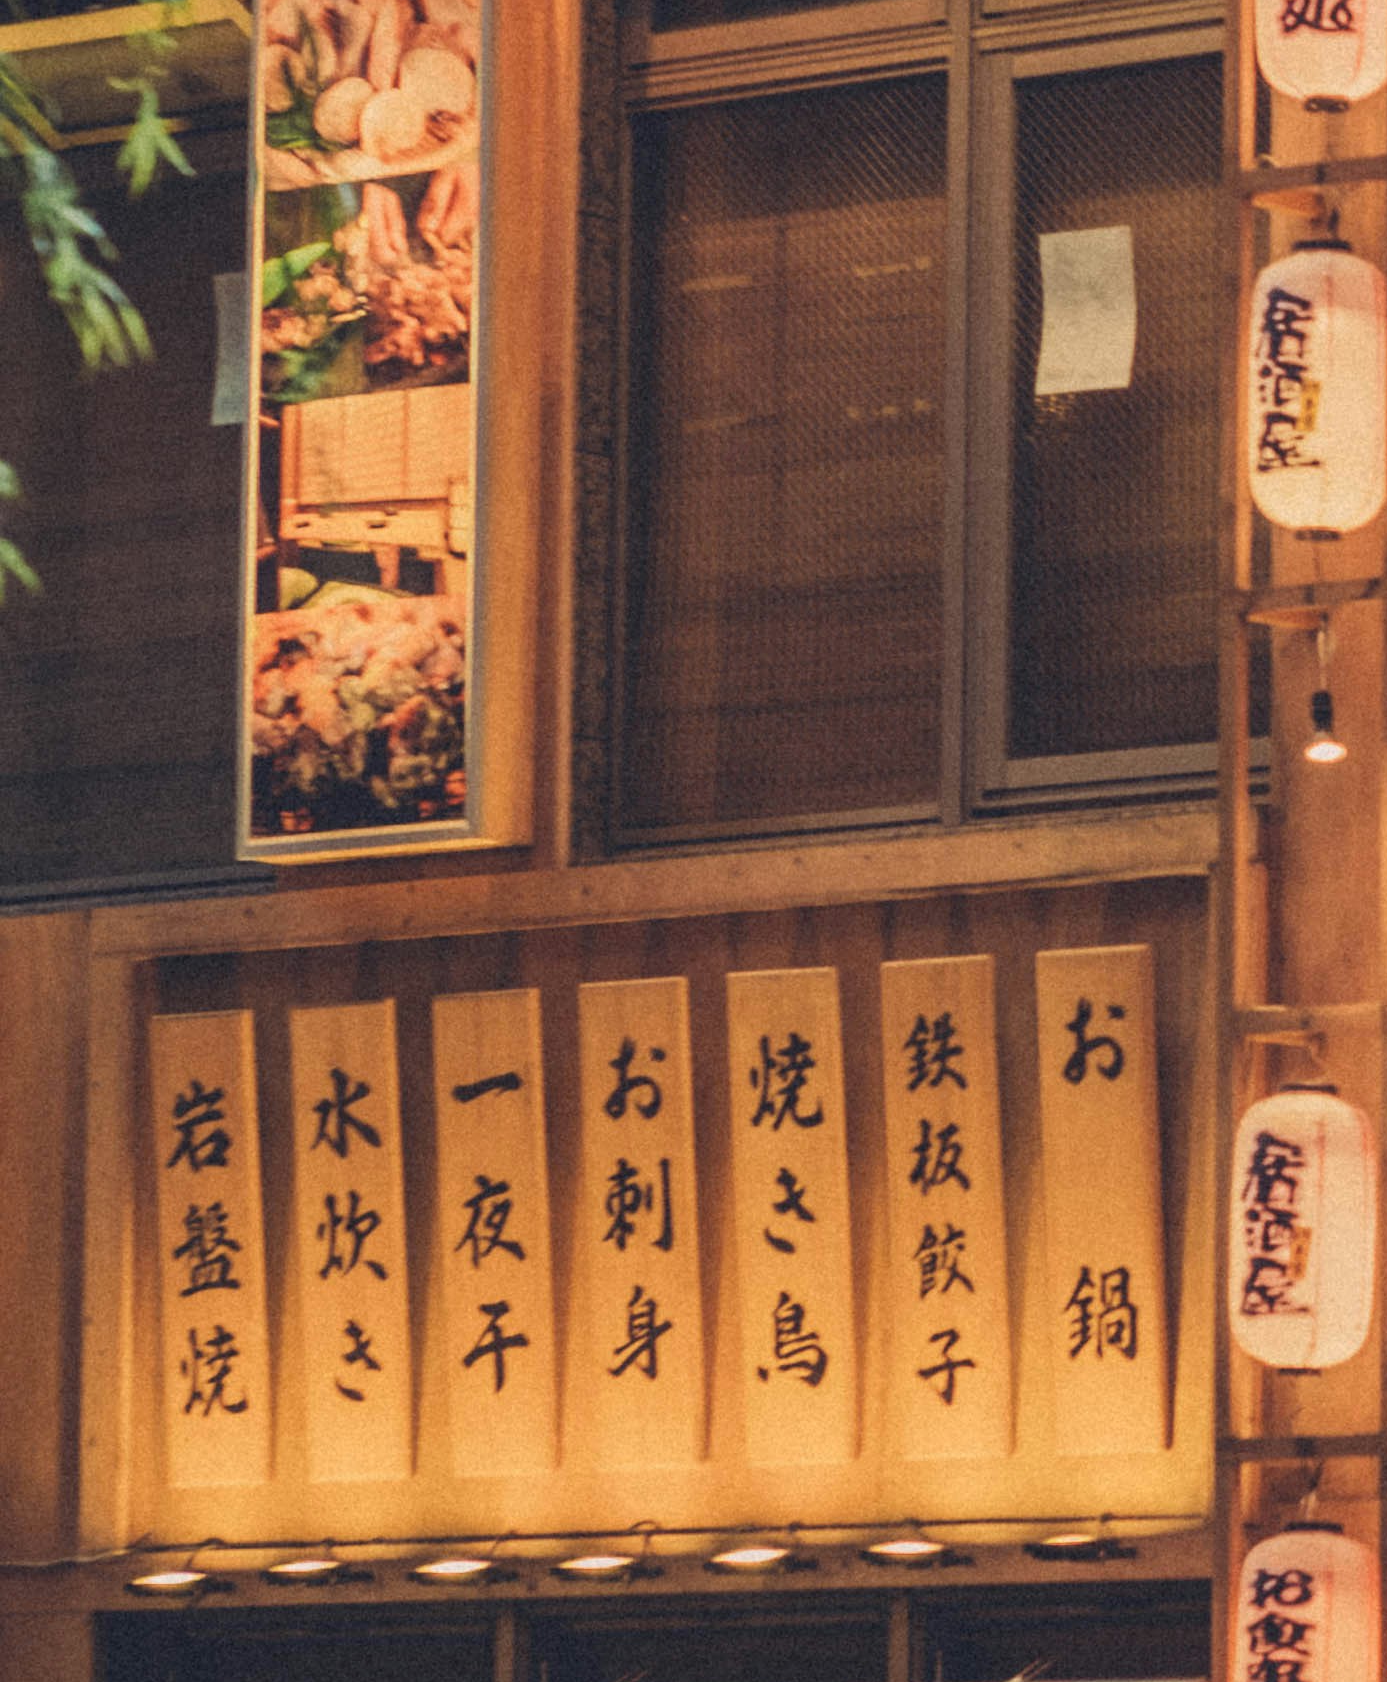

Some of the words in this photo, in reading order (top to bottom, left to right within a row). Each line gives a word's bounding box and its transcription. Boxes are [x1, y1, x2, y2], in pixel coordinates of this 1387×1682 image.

[165, 1079, 249, 1418] 岩盤焼
[310, 1067, 389, 1404] 水炊き
[451, 1071, 531, 1393] 一夜干
[602, 1035, 674, 1381] お刺身
[748, 1031, 829, 1388] 焼き鳥
[902, 1010, 977, 1406] 鉄板餃子
[1061, 996, 1139, 1363] お鍋
[1240, 1131, 1312, 1317] 居酒屋
